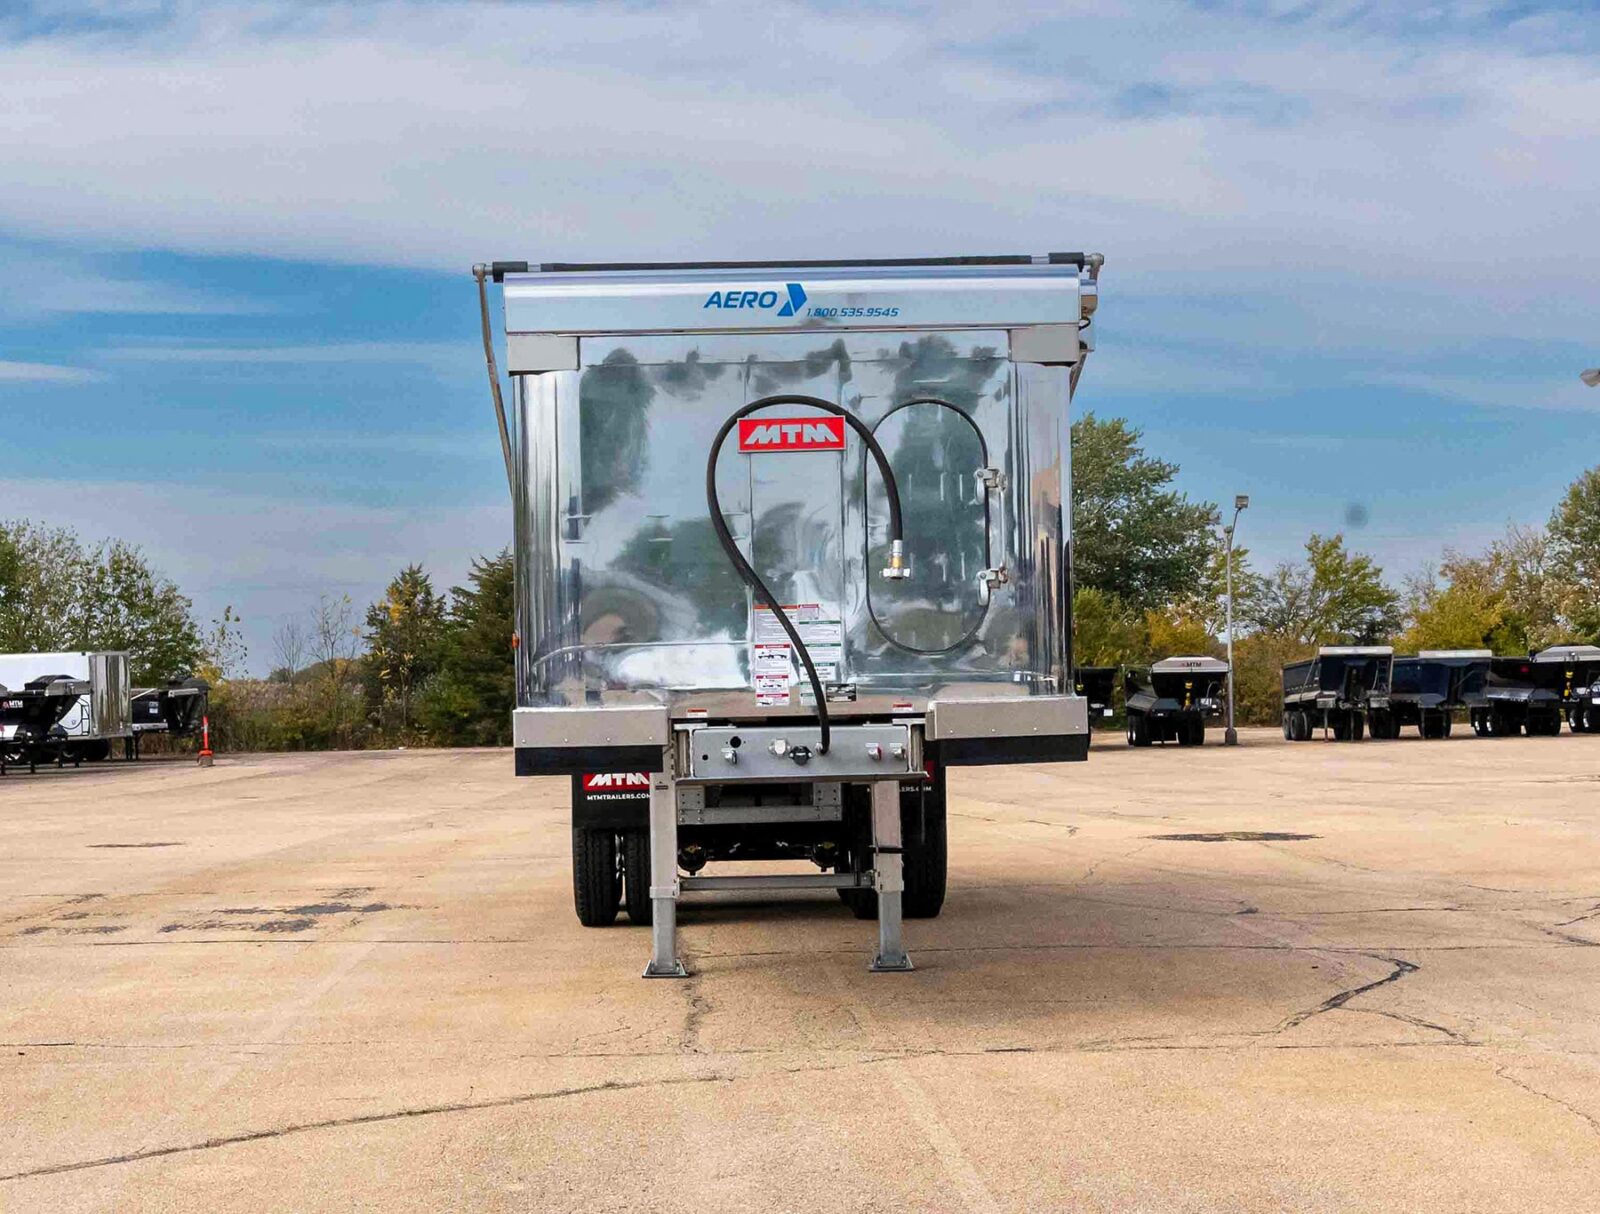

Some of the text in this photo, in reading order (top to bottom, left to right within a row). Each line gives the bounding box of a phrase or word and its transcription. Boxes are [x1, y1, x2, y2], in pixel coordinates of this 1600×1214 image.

[704, 291, 777, 308] AERO
[745, 424, 839, 444] MTM
[588, 773, 650, 786] MTM
